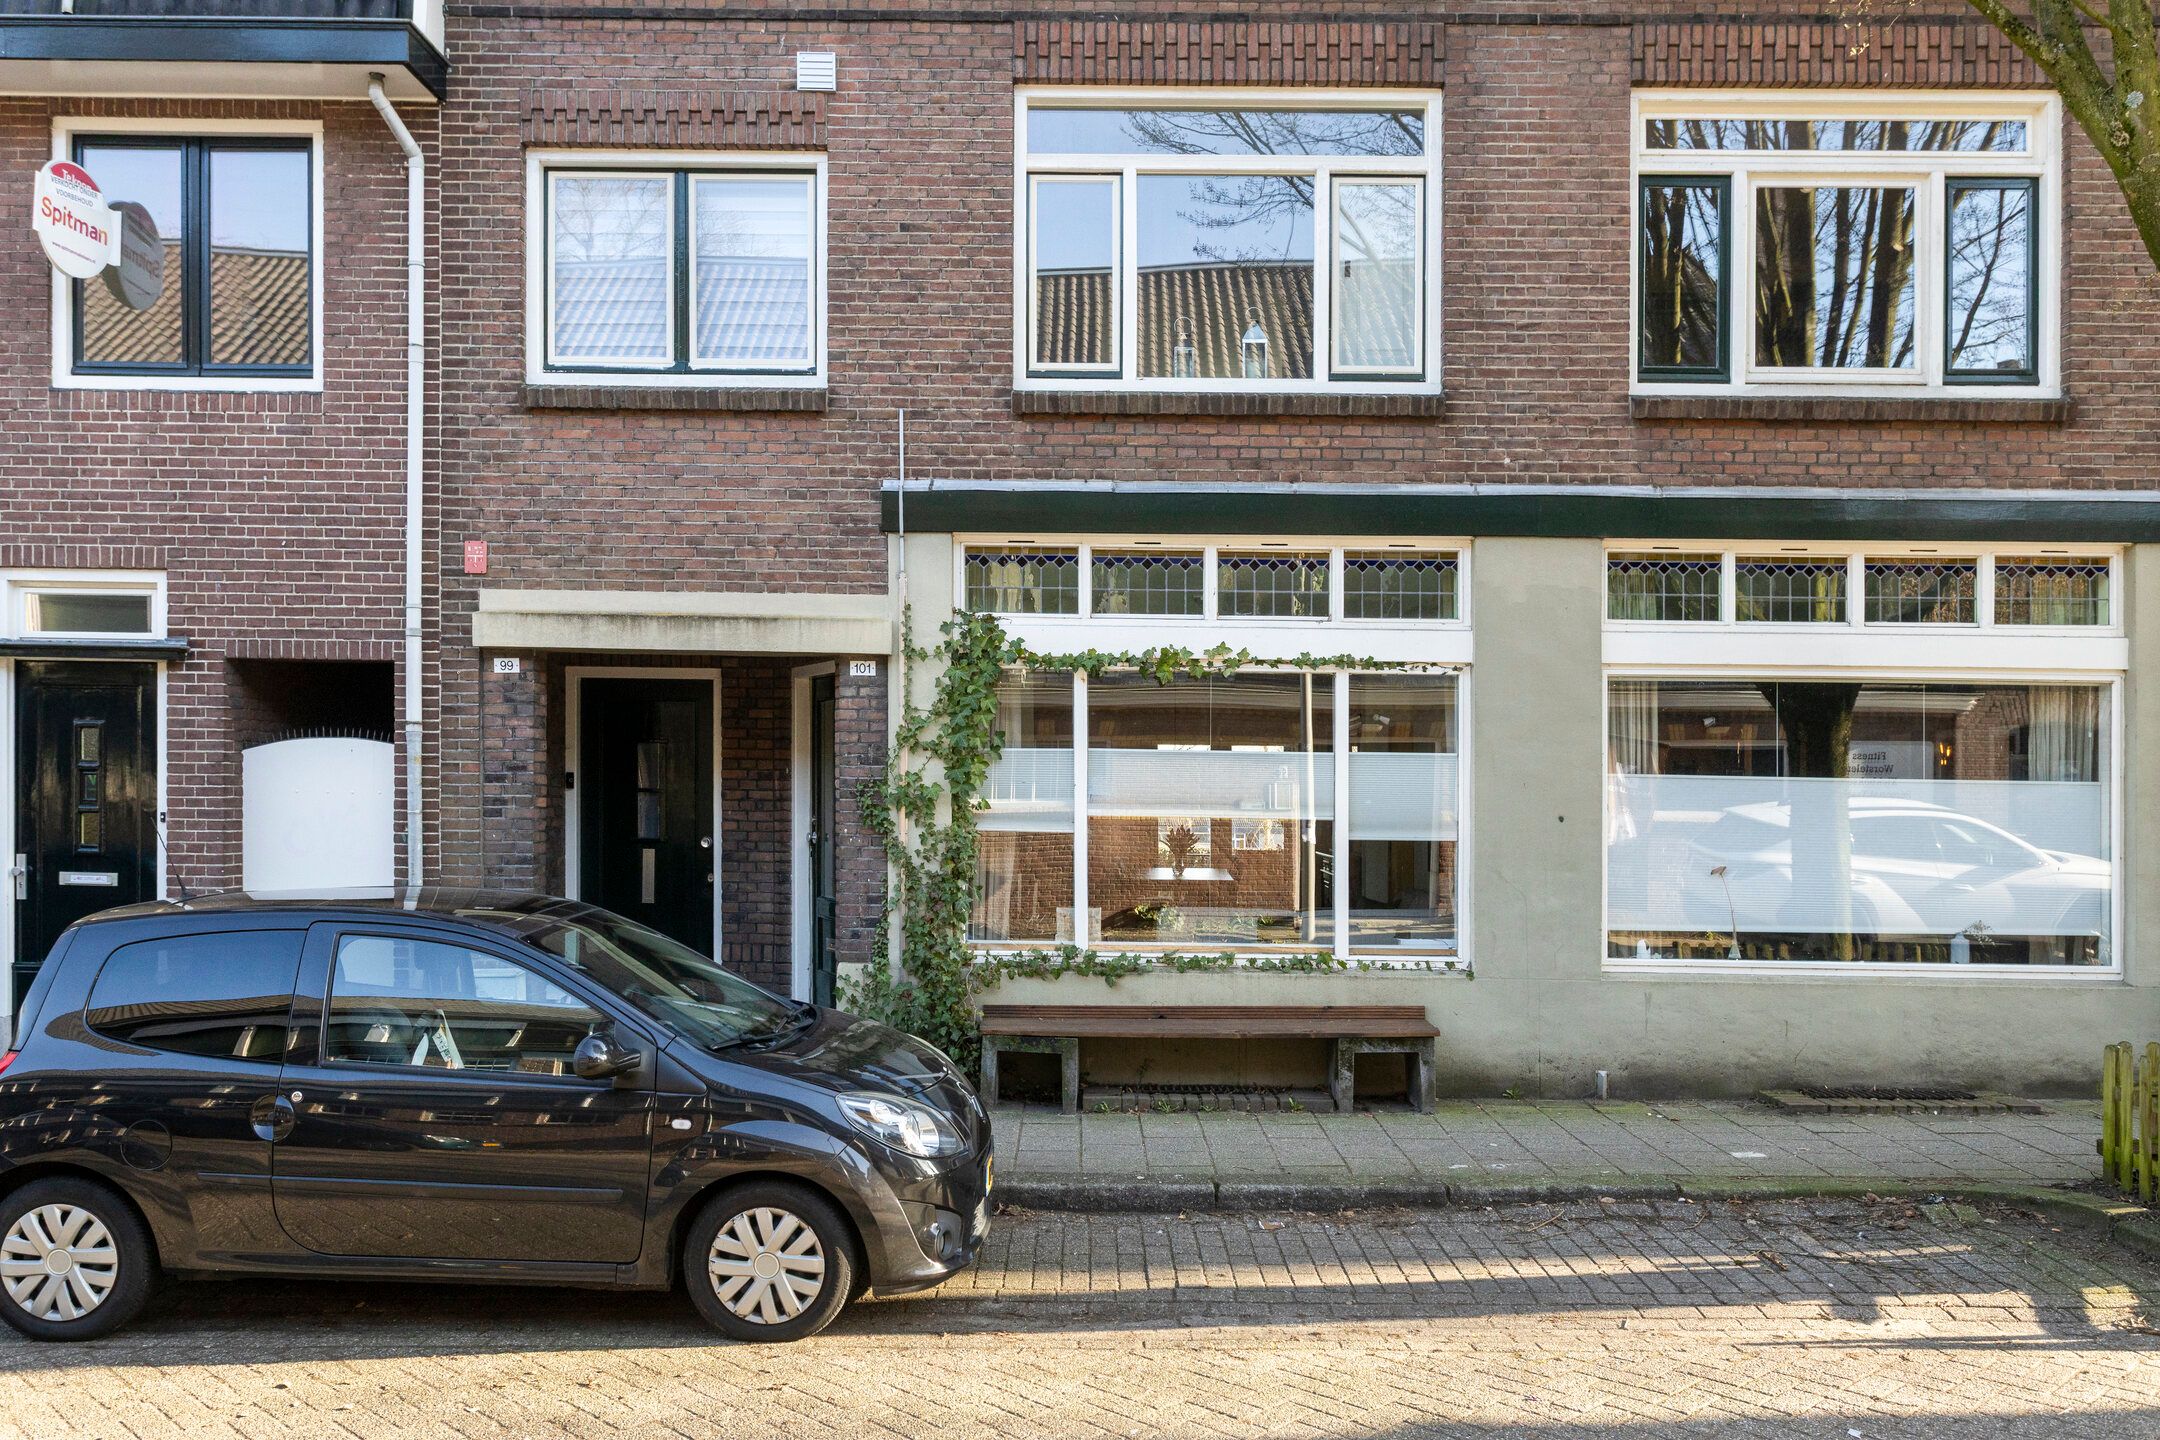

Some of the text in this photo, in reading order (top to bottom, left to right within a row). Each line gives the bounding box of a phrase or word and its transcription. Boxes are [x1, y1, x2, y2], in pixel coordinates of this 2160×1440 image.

[56, 188, 94, 208] VOORBEHOUD
[41, 196, 108, 246] Spitman
[500, 660, 514, 671] 99
[854, 662, 871, 674] 101
